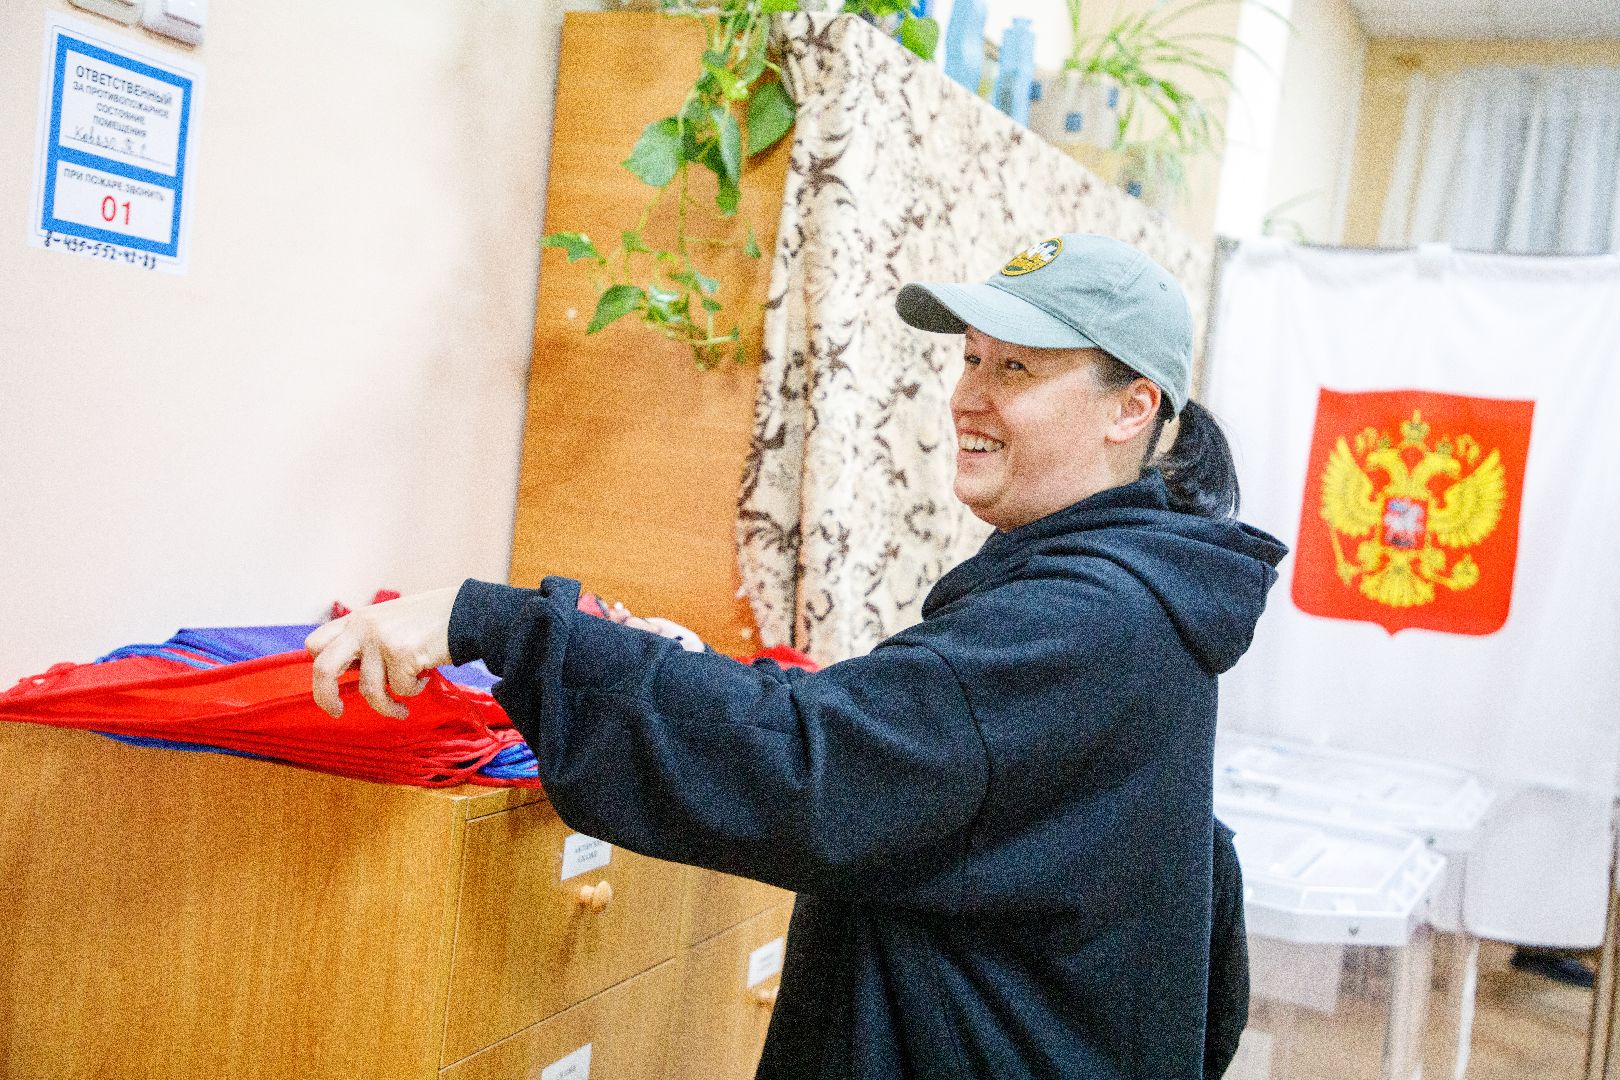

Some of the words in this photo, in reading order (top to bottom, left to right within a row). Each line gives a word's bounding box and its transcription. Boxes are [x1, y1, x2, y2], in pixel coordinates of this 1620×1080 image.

[75, 65, 172, 105] ОТВЕТСТВЕННЫЙ
[73, 81, 84, 92] ЗА
[86, 85, 168, 119] ПРОТИВОПОЖАРНОЕ
[97, 102, 145, 125] СОСТОЯНИЕ
[93, 115, 146, 137] ПОМЕЩЕНИЯ
[64, 168, 83, 181] ПРИ
[85, 174, 123, 192] ПОЖАРЕ
[102, 195, 130, 225] 01
